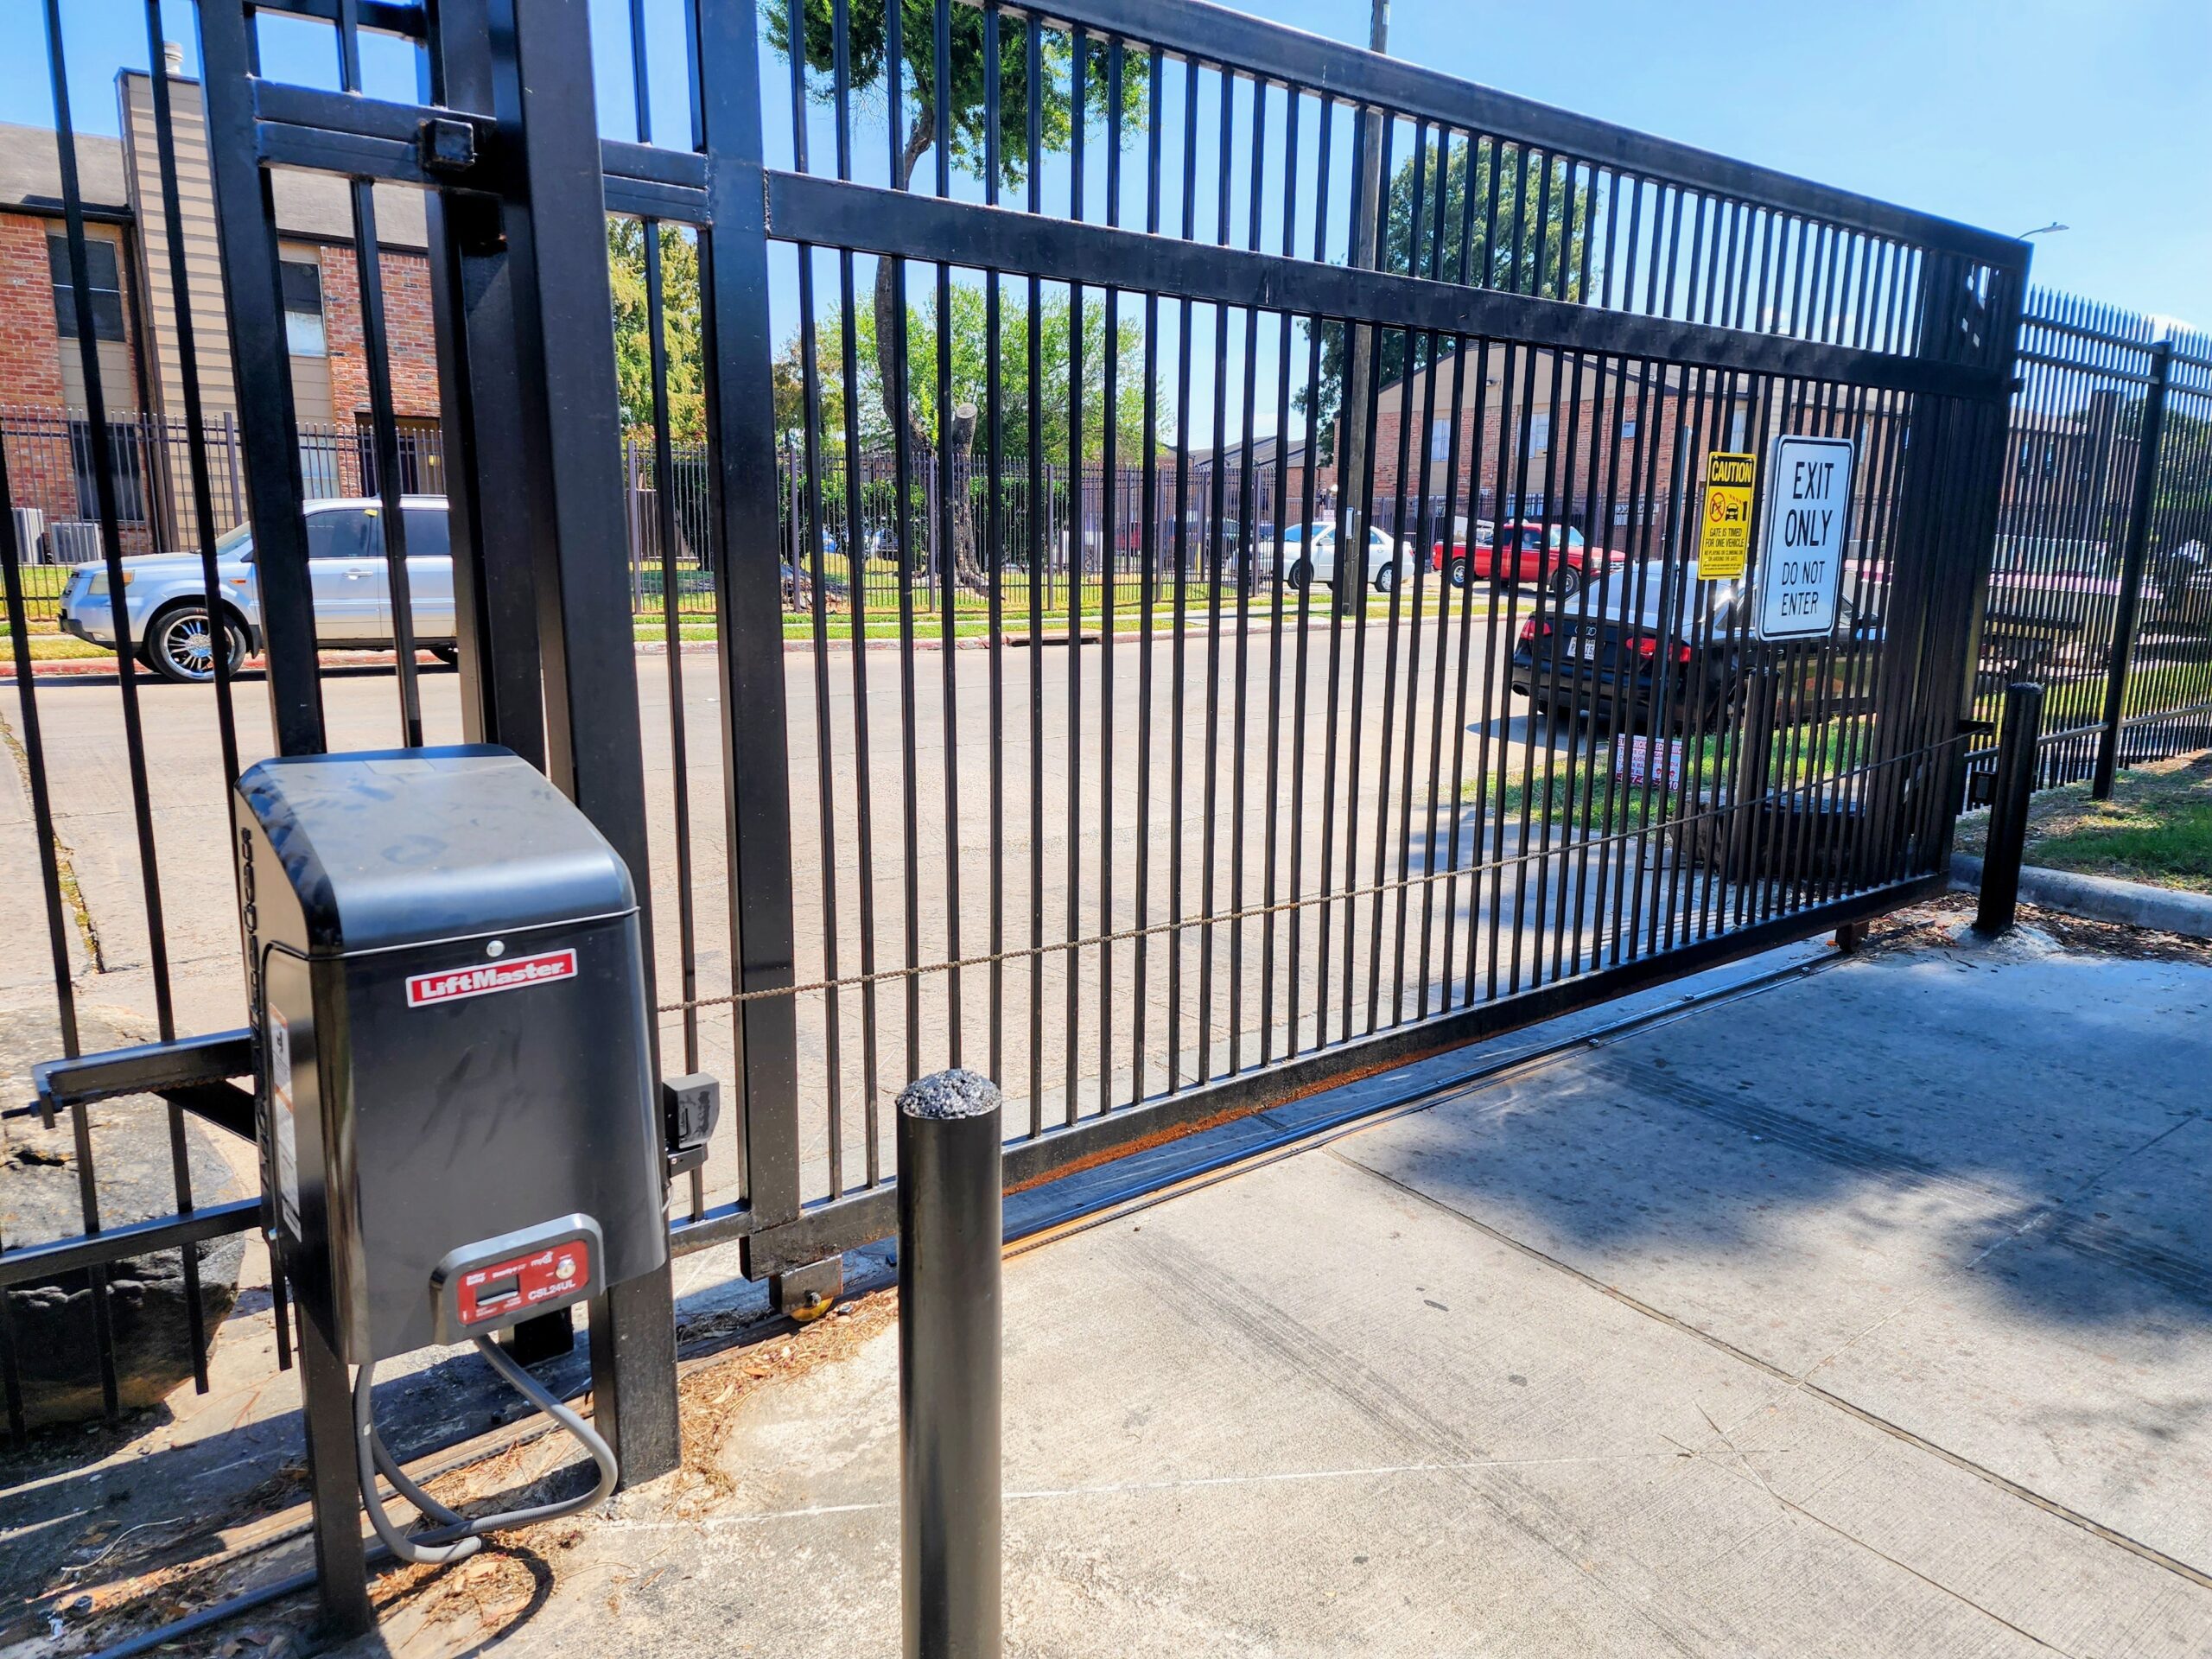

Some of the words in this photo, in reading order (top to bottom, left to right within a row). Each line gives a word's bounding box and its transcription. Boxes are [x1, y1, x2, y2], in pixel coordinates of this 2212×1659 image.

[1712, 460, 1752, 484] CAUTION
[1793, 461, 1834, 500] EXIT
[1709, 527, 1721, 537] GATE
[1722, 527, 1727, 537] IS
[1728, 527, 1742, 537] TIMED
[1784, 509, 1833, 547] ONLY
[1705, 538, 1714, 547] FOR
[1715, 538, 1725, 547] ONE
[1726, 538, 1745, 547] VEHICLE
[1781, 561, 1799, 585] DO
[1802, 561, 1825, 584] NOT
[1781, 591, 1818, 616] ENTER
[420, 961, 565, 999] LiftMaster
[527, 1279, 576, 1300] CSL24UL
